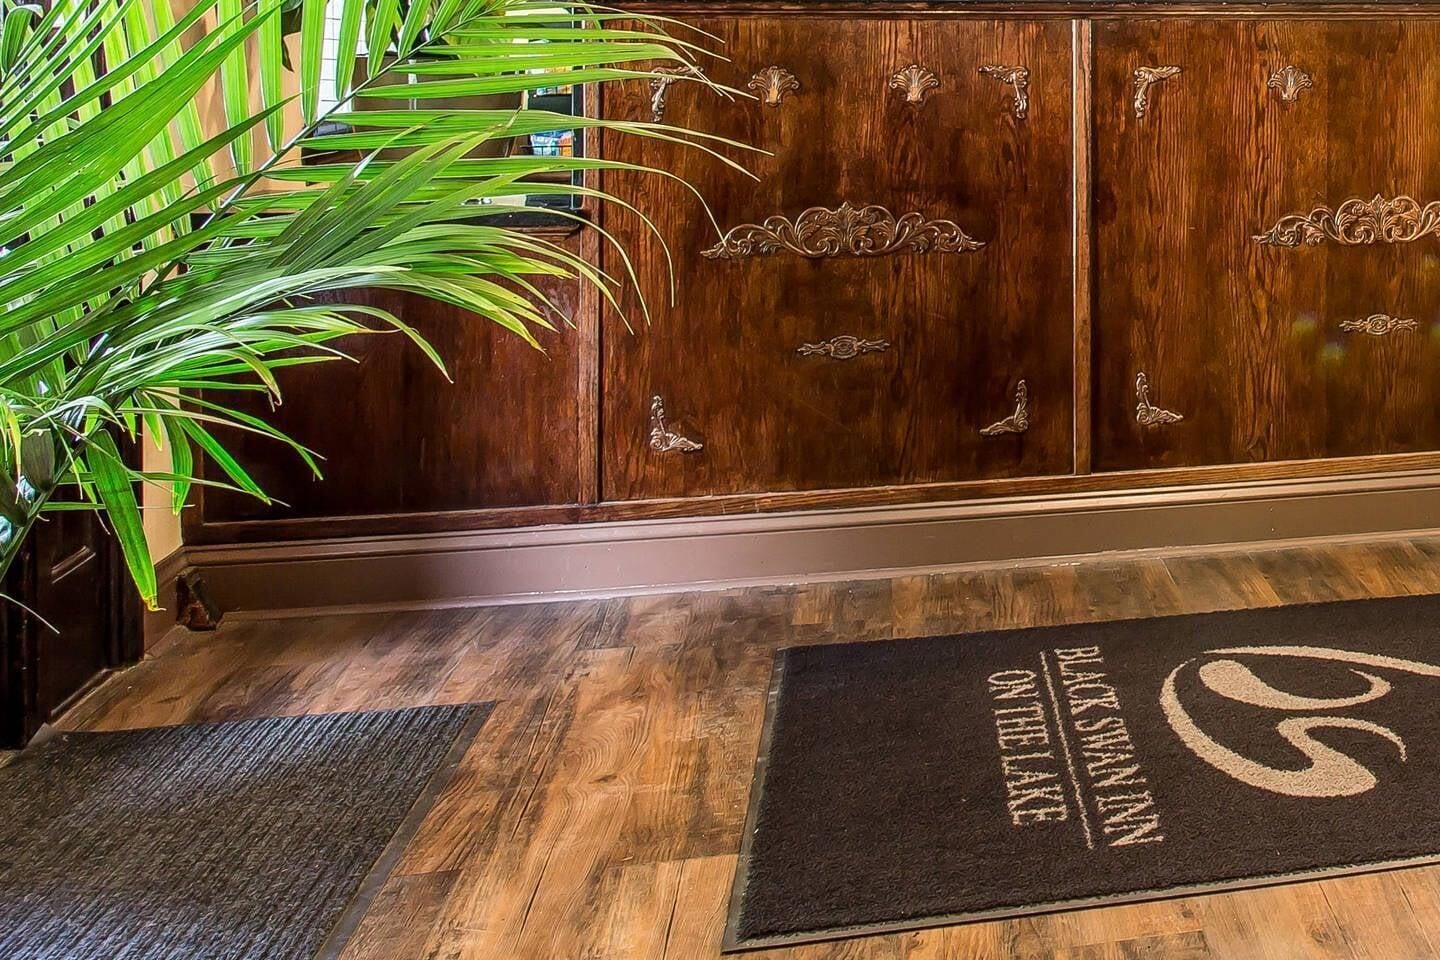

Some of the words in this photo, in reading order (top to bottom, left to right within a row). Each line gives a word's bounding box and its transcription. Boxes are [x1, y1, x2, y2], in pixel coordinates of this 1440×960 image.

[987, 669, 1040, 700] ON
[1054, 646, 1121, 716] BLACK
[994, 701, 1050, 750] THE
[1074, 717, 1147, 788] SWAN
[1001, 751, 1068, 826] LAKE
[1096, 791, 1165, 847] INN
